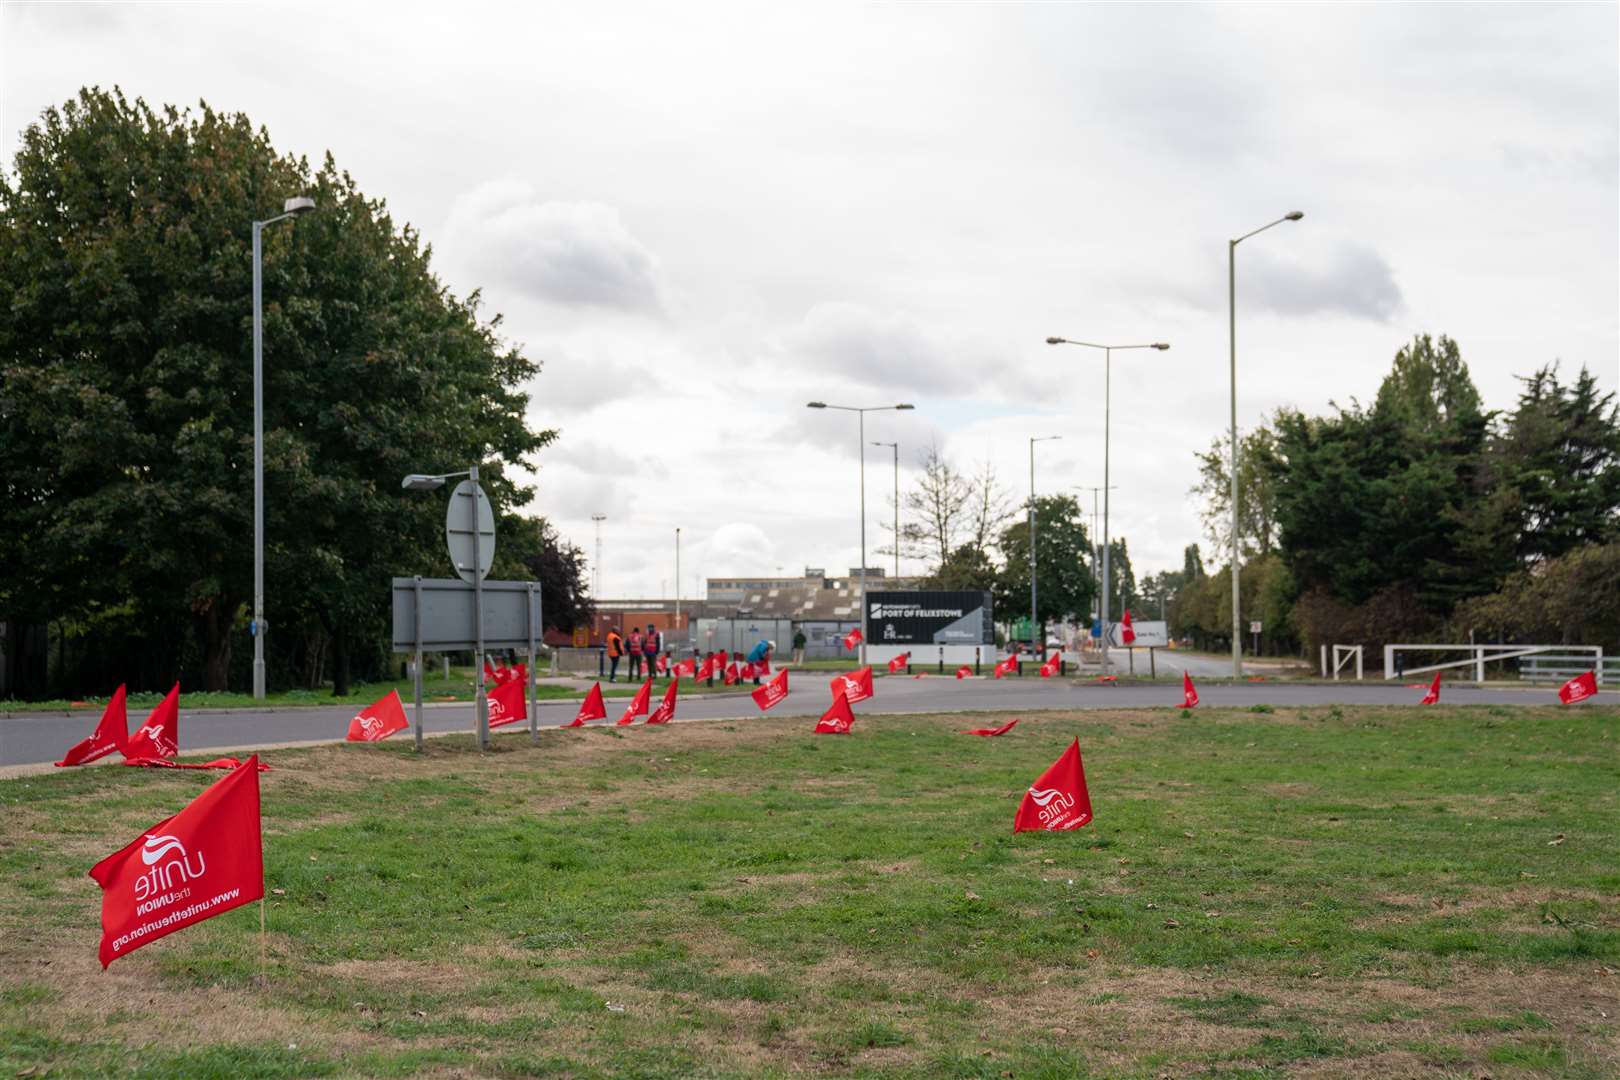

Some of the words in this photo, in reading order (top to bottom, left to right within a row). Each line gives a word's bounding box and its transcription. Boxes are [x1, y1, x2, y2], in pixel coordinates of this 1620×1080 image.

[883, 609, 902, 618] PORT
[903, 609, 914, 618] OF
[915, 609, 962, 618] FELIXSTOWE
